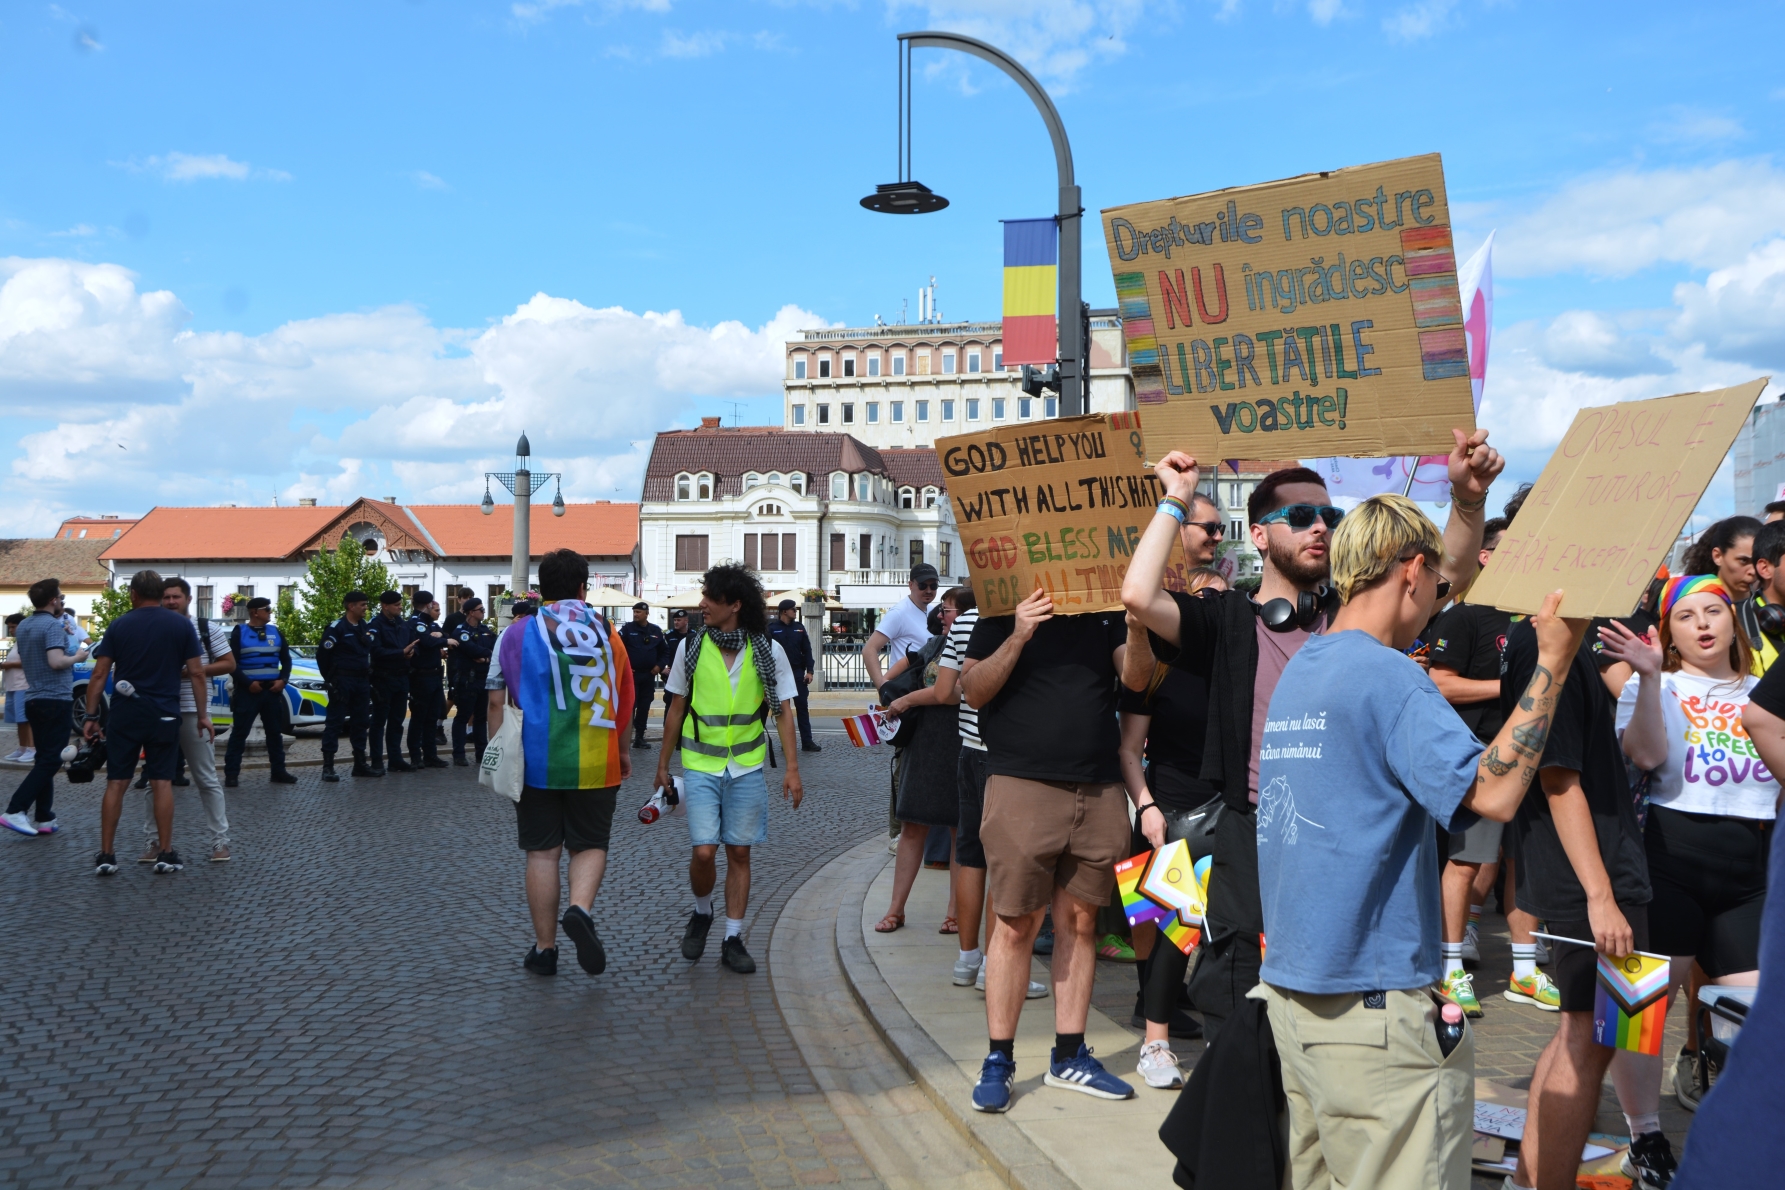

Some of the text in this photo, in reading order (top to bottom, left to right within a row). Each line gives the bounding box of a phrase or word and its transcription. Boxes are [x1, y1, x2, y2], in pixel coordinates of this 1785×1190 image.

[1111, 185, 1435, 261] Drepturile noastre
[1158, 252, 1409, 329] NU îngrădesc
[1159, 319, 1382, 395] LIBERTĂȚILE
[1210, 387, 1348, 435] voastre!
[1685, 403, 1725, 446] E
[943, 431, 1107, 477] GOD HELP YOU
[956, 474, 1167, 523] WITH ALL THIS HAT
[1531, 470, 1681, 507] AL TUTUROR
[970, 535, 1017, 570] GOD
[1022, 526, 1101, 565] BLESS
[983, 574, 1023, 609] FOR
[1289, 719, 1302, 731] nu
[1302, 711, 1327, 730] lasă
[1684, 725, 1762, 760] is FREE
[1697, 744, 1726, 766] to
